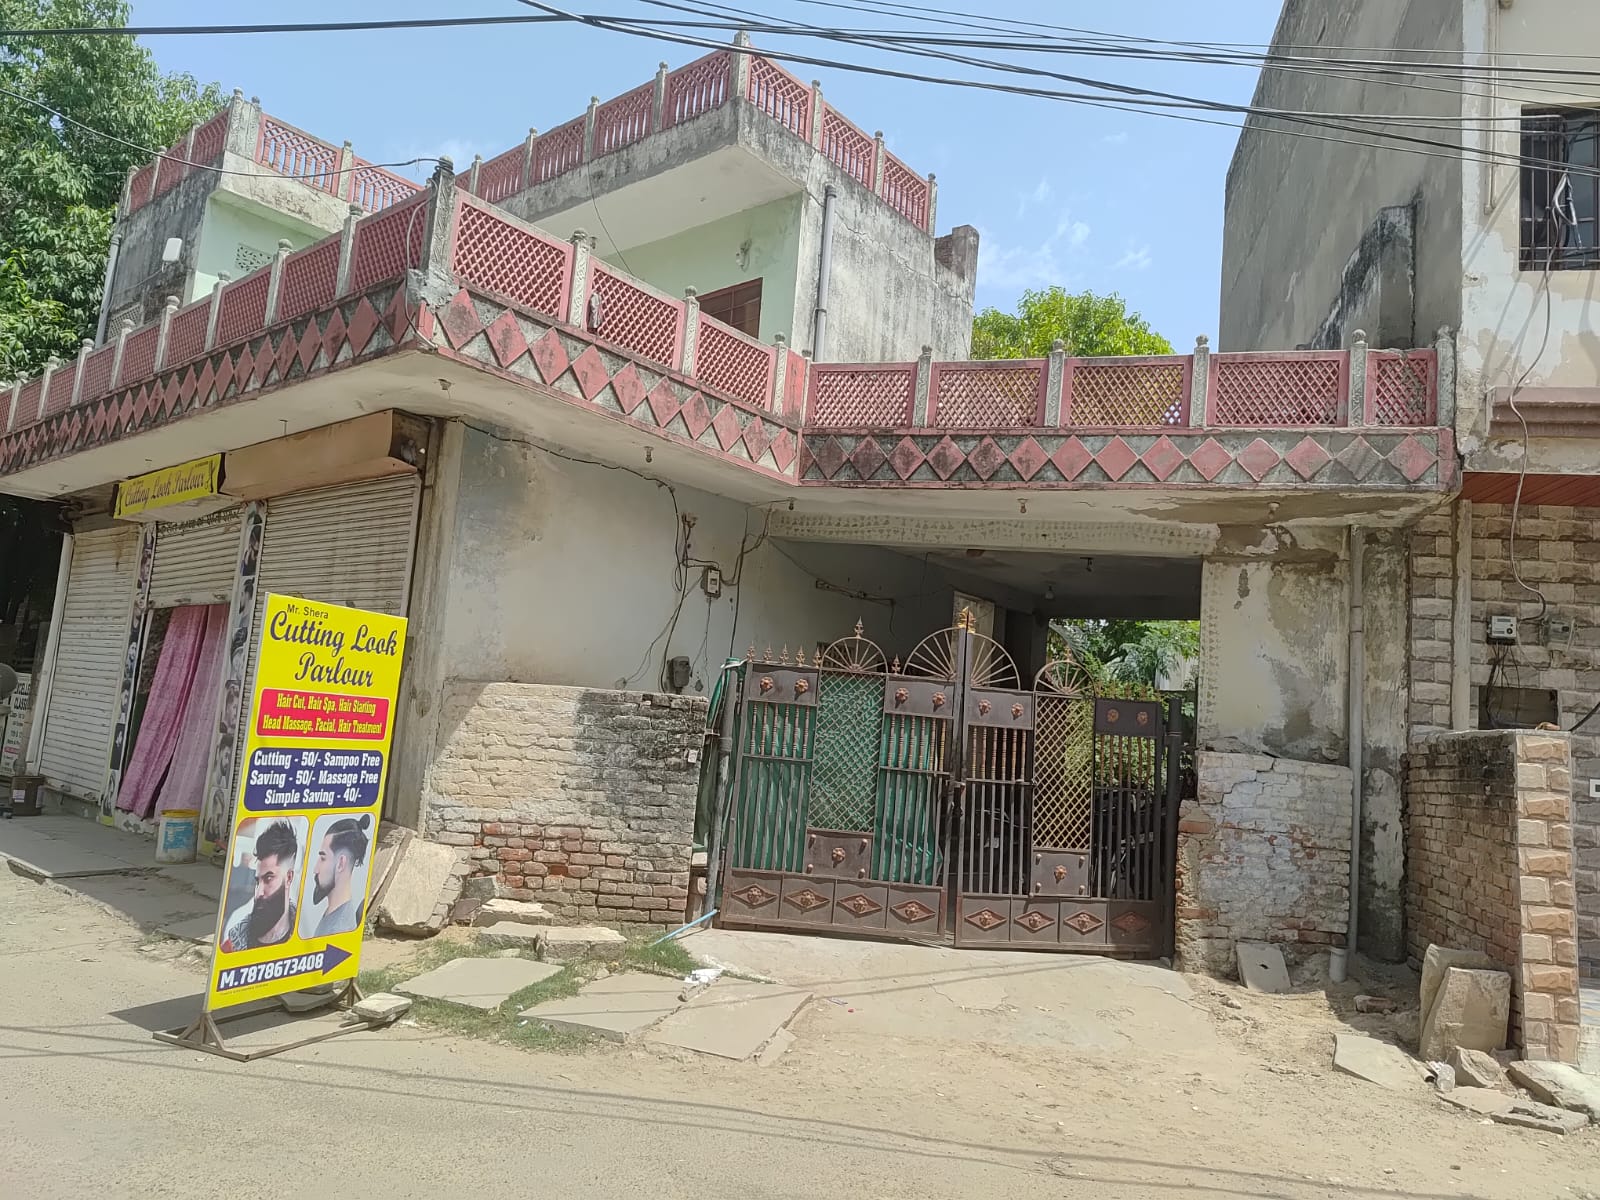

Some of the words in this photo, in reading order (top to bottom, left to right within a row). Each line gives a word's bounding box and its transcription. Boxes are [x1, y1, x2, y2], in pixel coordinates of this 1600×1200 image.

[287, 603, 300, 616] Mr.
[303, 606, 329, 619] Shera
[270, 610, 345, 657] Cutting
[350, 624, 398, 656] Look
[294, 651, 374, 687] Parlour
[277, 693, 292, 708] Hair
[293, 695, 306, 710] Cut,
[307, 696, 322, 711] Hair
[339, 698, 352, 712] Hair
[263, 715, 281, 729] Head
[282, 715, 314, 734] Massage,
[315, 717, 336, 733] Facial,
[338, 719, 352, 733] Hair
[353, 720, 382, 734] Treatment
[254, 751, 292, 769] Cutting
[301, 751, 321, 768] 50/-
[324, 752, 359, 770] Sampoo
[361, 753, 380, 767] Free
[250, 770, 285, 788] Saving
[295, 770, 316, 786] 50/-
[318, 770, 358, 786] Massage
[359, 770, 379, 784] Free
[264, 789, 300, 807] Simple
[302, 788, 335, 805] Saving
[343, 788, 362, 803] 40/-
[220, 953, 324, 989] M.7878673408
